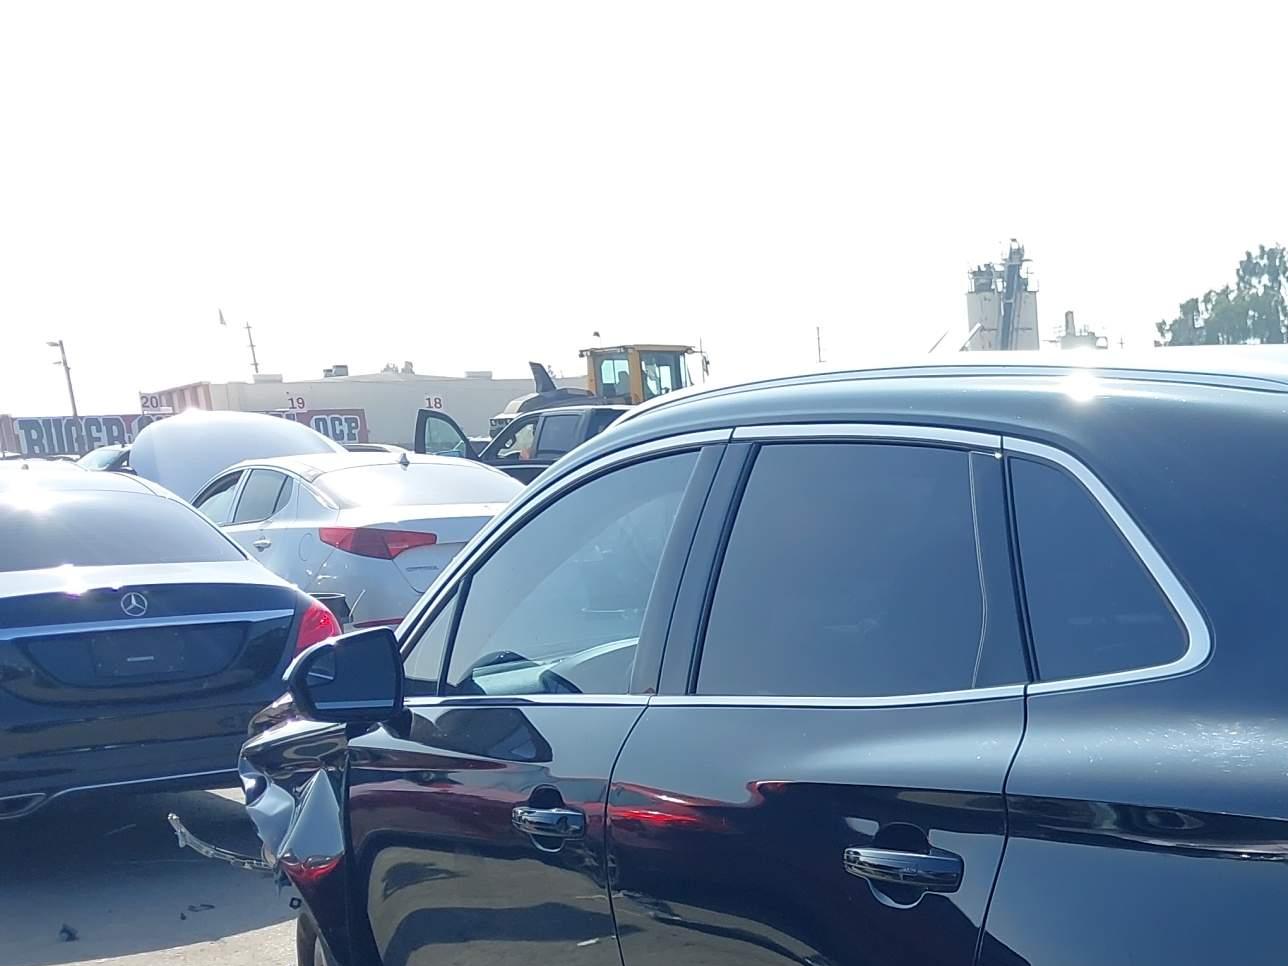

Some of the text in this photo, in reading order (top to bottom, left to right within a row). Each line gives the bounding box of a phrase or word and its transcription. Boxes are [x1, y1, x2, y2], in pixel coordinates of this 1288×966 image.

[140, 395, 159, 409] 20
[287, 397, 305, 410] 19
[425, 397, 442, 409] 18
